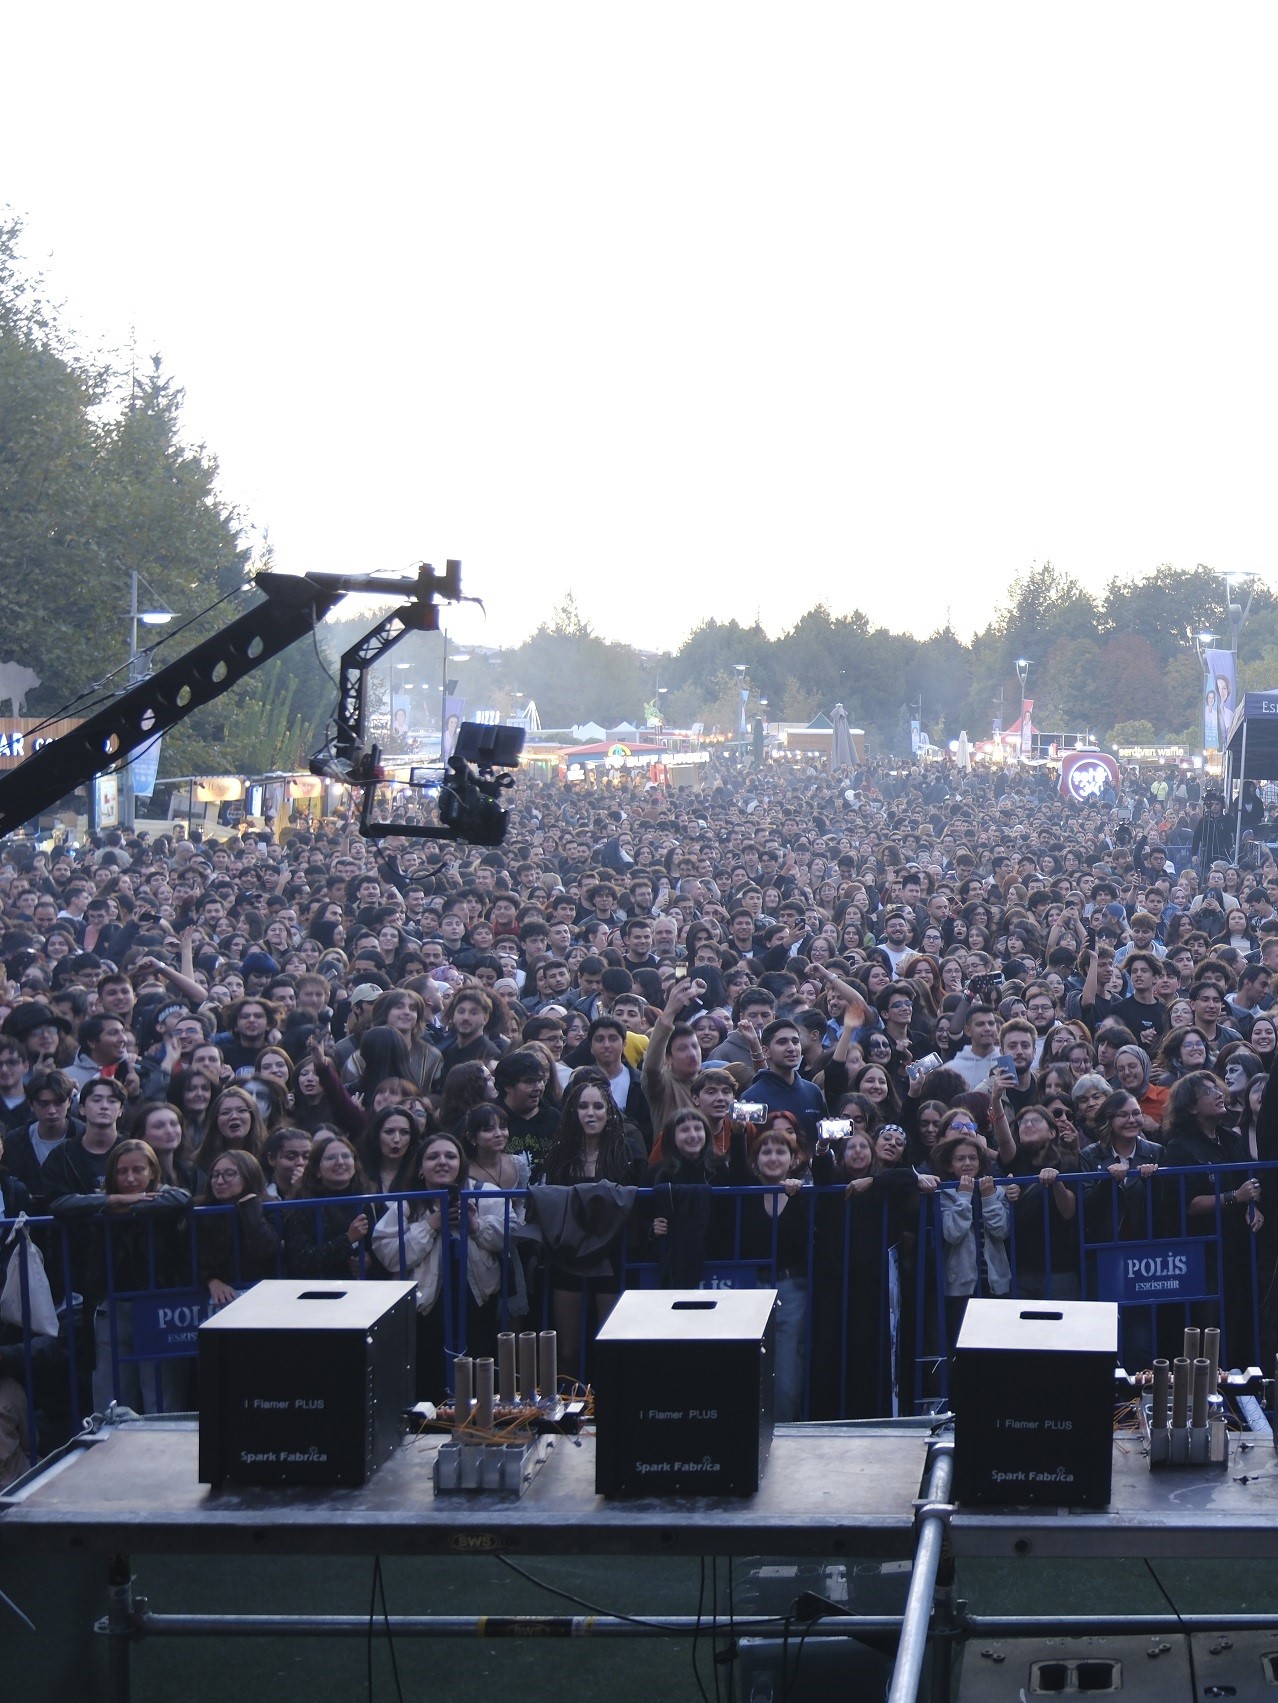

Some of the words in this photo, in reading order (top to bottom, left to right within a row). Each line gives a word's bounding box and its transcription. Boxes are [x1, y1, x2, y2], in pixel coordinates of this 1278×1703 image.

[1127, 1251, 1187, 1278] POLİS
[254, 1398, 290, 1409] Flamer
[295, 1399, 326, 1409] PLUS
[648, 1409, 684, 1420] Flamer
[689, 1409, 718, 1420] PLUS
[1005, 1419, 1040, 1429] Flamer
[1044, 1420, 1073, 1430] PLUS
[241, 1450, 277, 1464] Spark
[280, 1447, 328, 1462] Fabrica
[635, 1461, 671, 1474] Spark
[674, 1456, 721, 1472] Fabrica
[991, 1469, 1026, 1483] Spark
[1028, 1466, 1074, 1482] Fabrica
[457, 1535, 492, 1547] SWS
